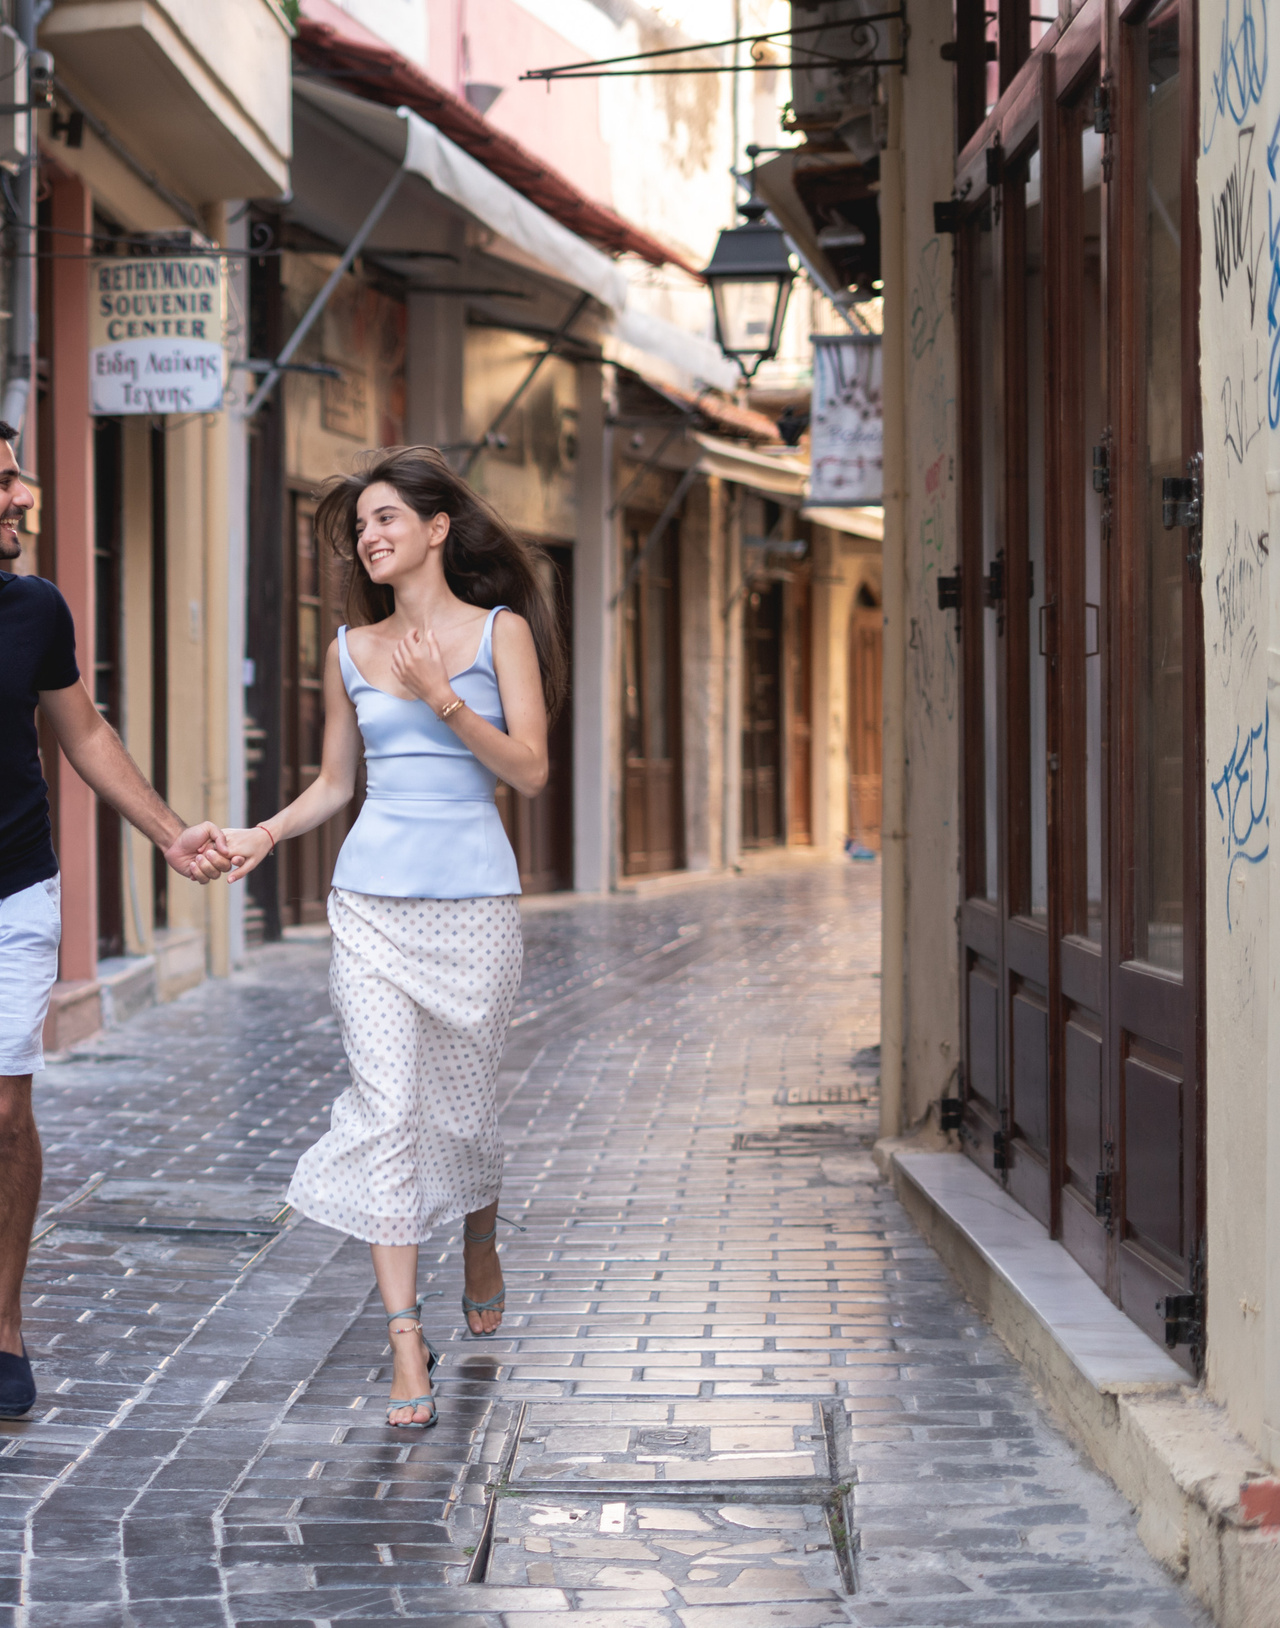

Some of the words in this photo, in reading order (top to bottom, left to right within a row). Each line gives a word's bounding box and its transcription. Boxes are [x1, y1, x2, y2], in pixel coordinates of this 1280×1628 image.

[98, 262, 216, 291] RETHYMNON
[100, 293, 212, 317] SOUVENIR
[107, 319, 206, 340] CENTER
[96, 350, 138, 381] Ειδη
[145, 350, 217, 379] Λαϊκης
[123, 384, 193, 412] Τεχνης
